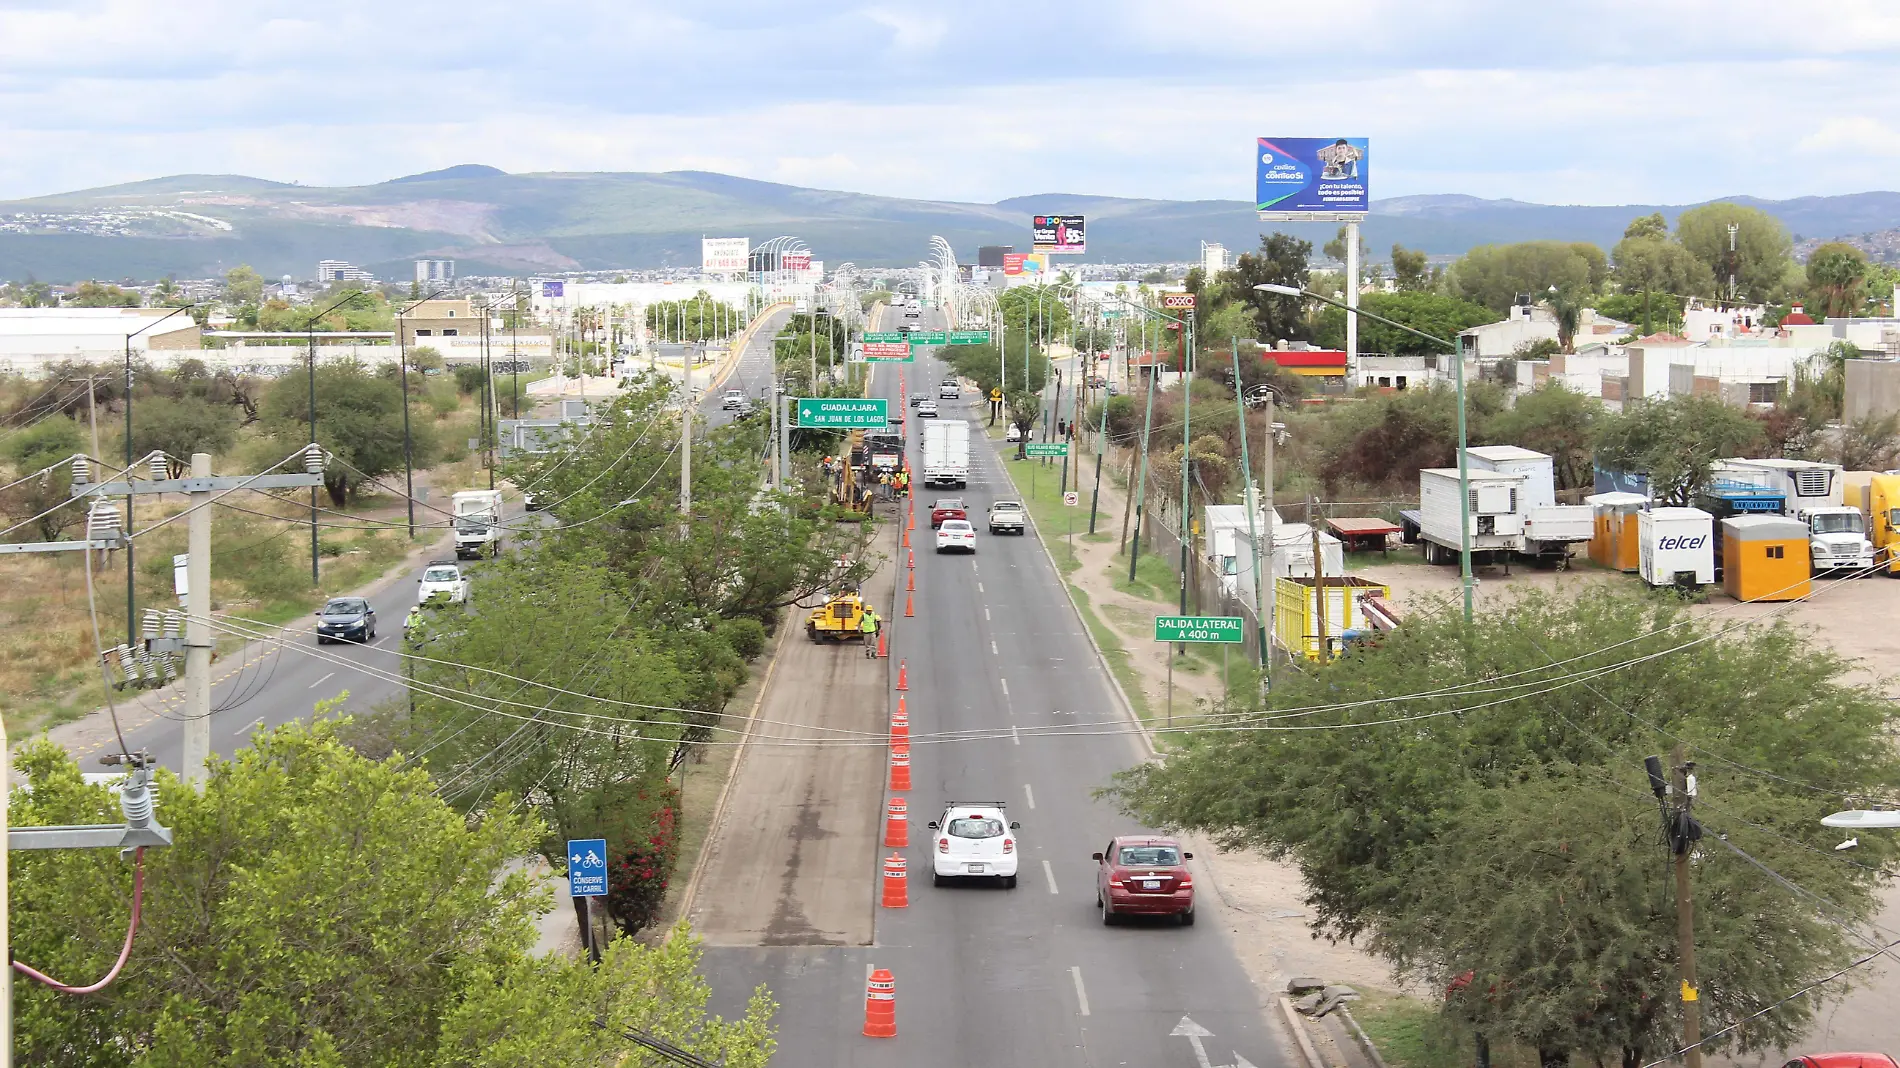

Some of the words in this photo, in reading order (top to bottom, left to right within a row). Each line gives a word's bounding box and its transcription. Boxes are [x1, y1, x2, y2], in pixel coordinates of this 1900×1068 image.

[1035, 217, 1059, 226] expo
[1166, 297, 1193, 305] OXXO
[1659, 535, 1707, 550] telcel
[1159, 619, 1193, 628] SALIDA
[1196, 620, 1239, 629] LATERAL
[1179, 630, 1185, 638] A
[1188, 630, 1208, 639] 400
[574, 876, 603, 884] CONSERVE
